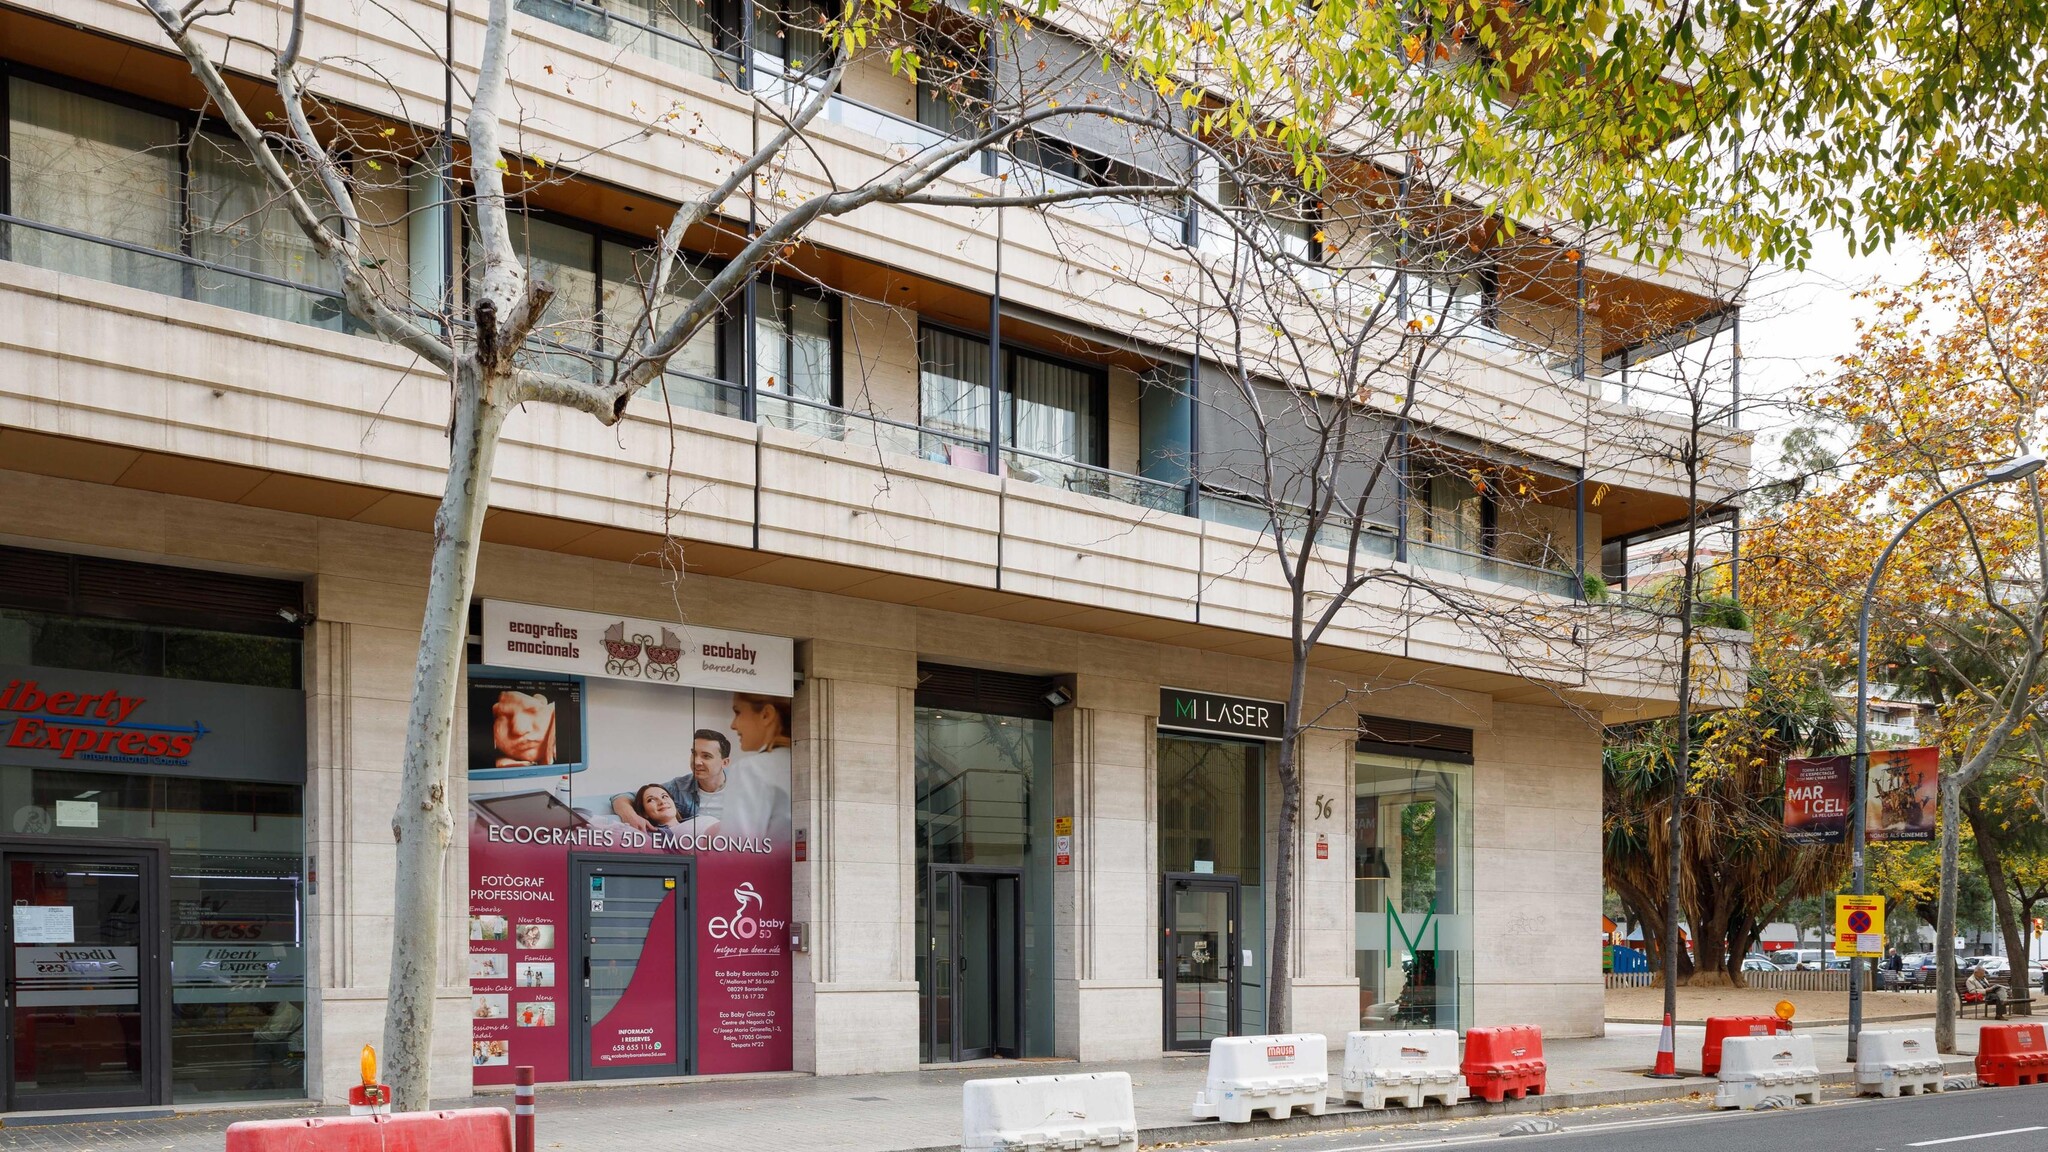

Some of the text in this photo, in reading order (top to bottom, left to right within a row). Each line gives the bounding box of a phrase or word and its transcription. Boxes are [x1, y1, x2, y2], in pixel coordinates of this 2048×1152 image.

[509, 620, 578, 641] ecografies
[507, 640, 579, 659] emocionals
[703, 642, 757, 664] ecobaby
[702, 660, 757, 676] barcelona
[0, 679, 145, 726] iberty
[1175, 698, 1269, 728] MI LASER
[7, 718, 196, 759] Express
[1788, 786, 1824, 801] MAR
[1314, 795, 1334, 820] 56
[1804, 799, 1844, 814] I CEL
[488, 824, 614, 847] ECOGRAFIES
[620, 830, 646, 848] 5D
[652, 832, 772, 854] EMOCIONALS
[481, 874, 545, 887] FOTÒGRAF
[470, 890, 554, 901] PROFESSIONAL
[759, 919, 785, 929] baby
[759, 930, 772, 939] 5D
[1386, 896, 1438, 969] M
[206, 949, 261, 961] Liberty
[713, 944, 737, 956] Imatges
[739, 947, 750, 956] que
[769, 945, 781, 953] vida
[726, 970, 741, 978] Baby
[1268, 1046, 1294, 1056] MAUSA
